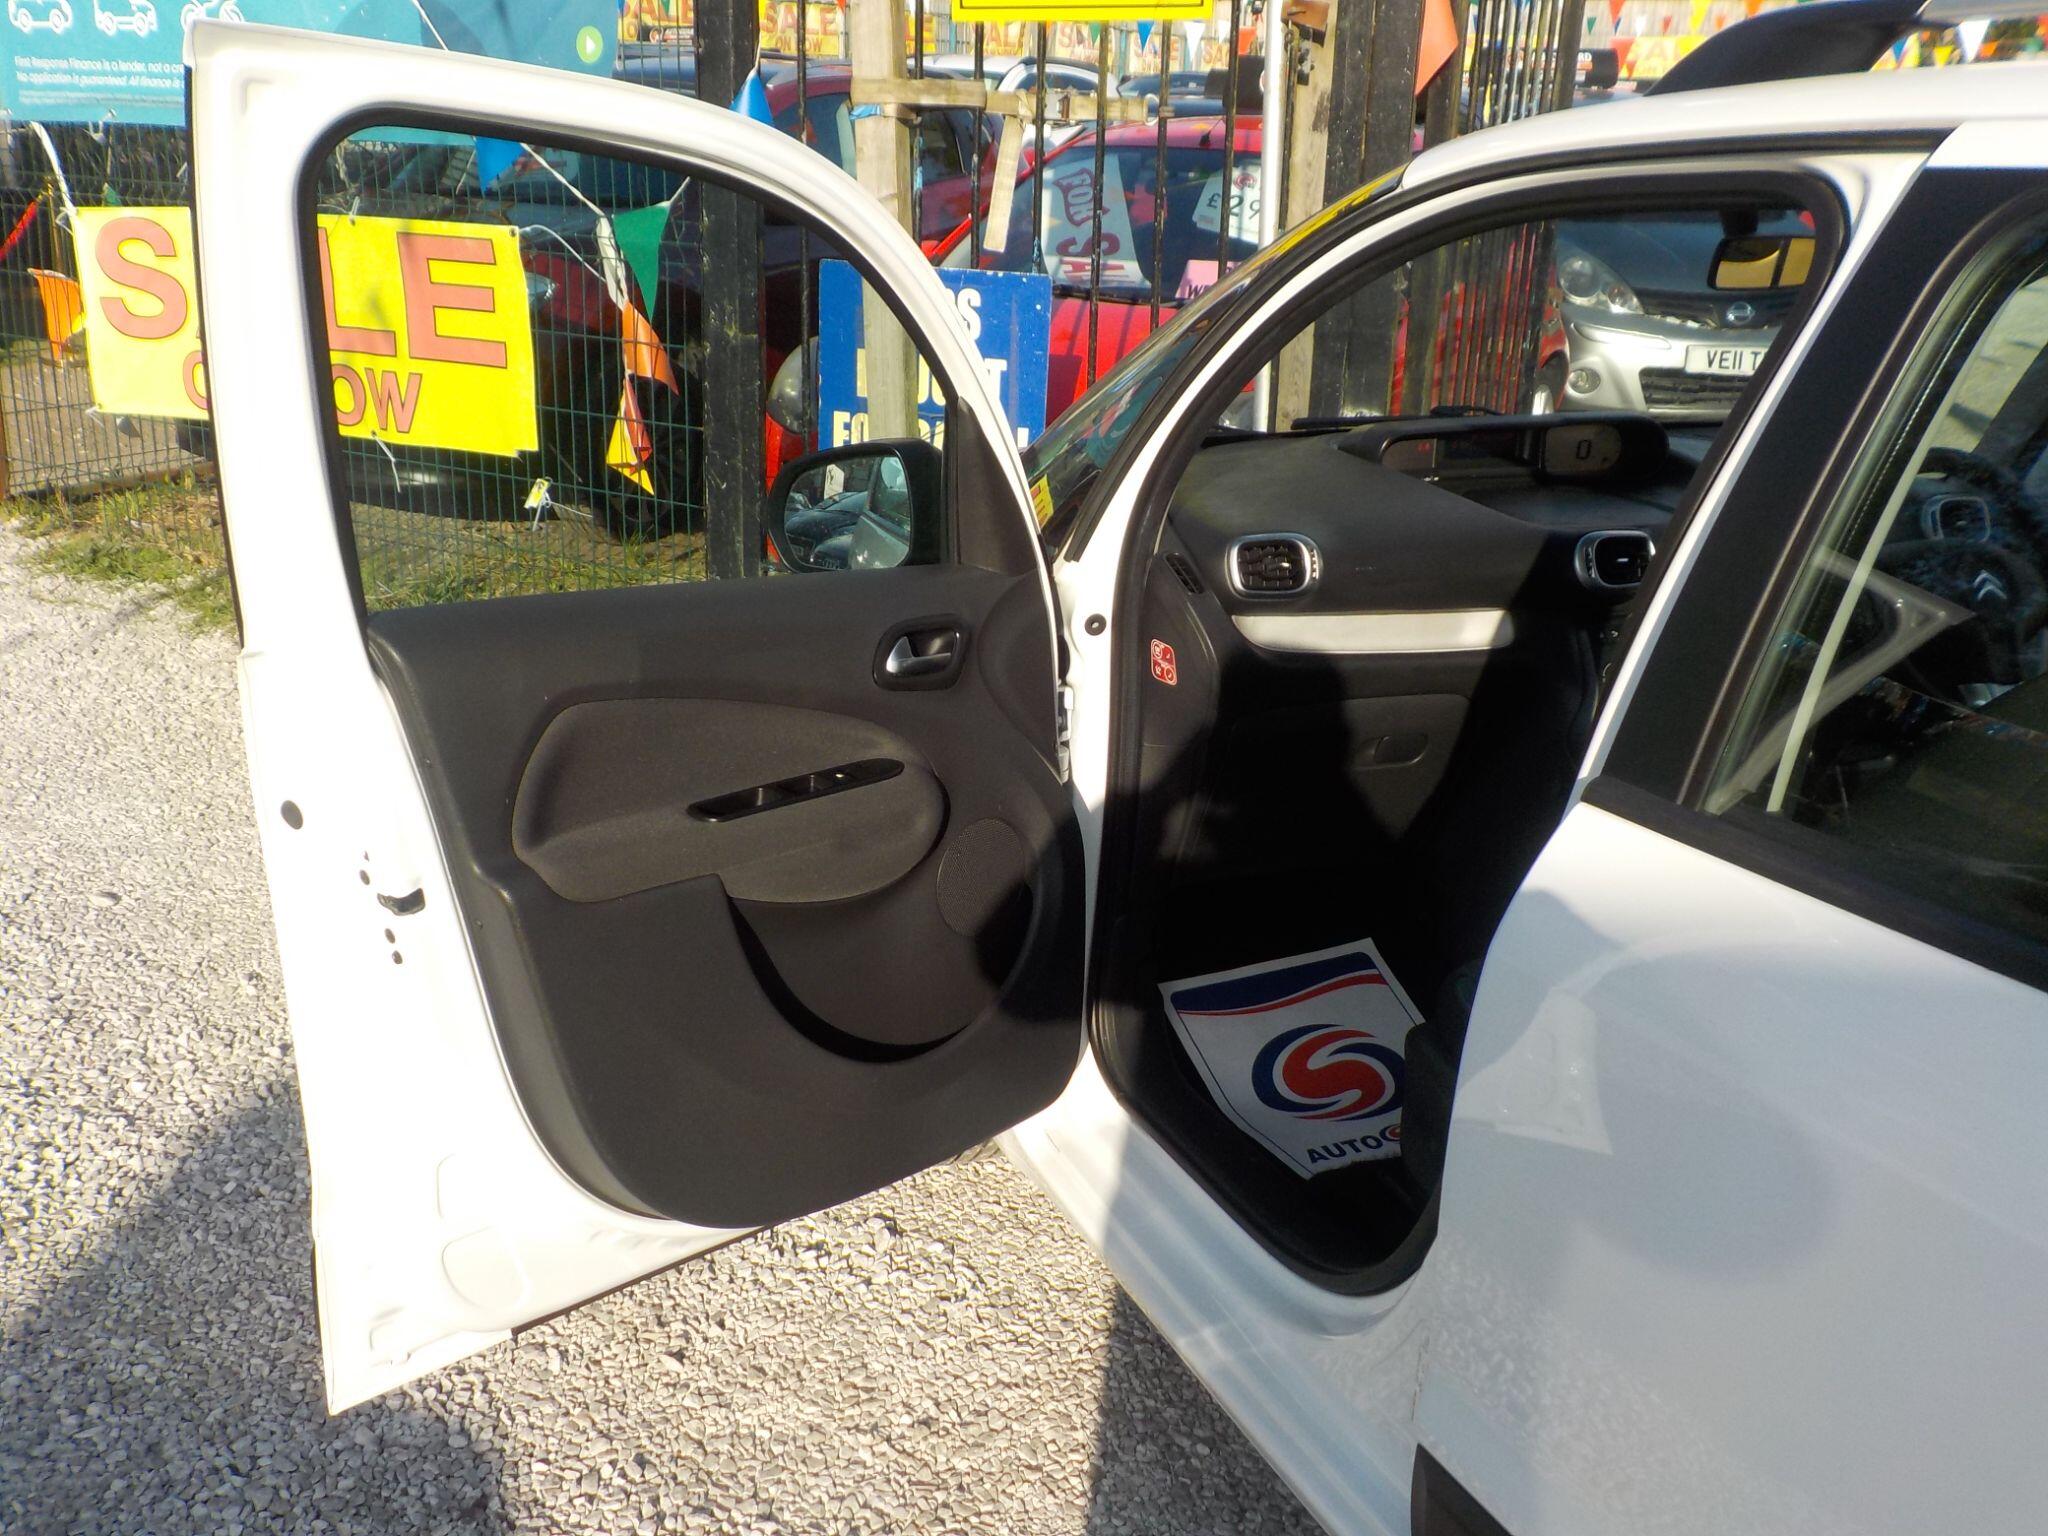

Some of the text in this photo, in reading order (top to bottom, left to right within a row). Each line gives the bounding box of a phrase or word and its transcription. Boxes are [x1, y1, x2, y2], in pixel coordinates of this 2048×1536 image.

[147, 62, 162, 73] not
[95, 216, 507, 368] SLE
[331, 363, 422, 433] OW
